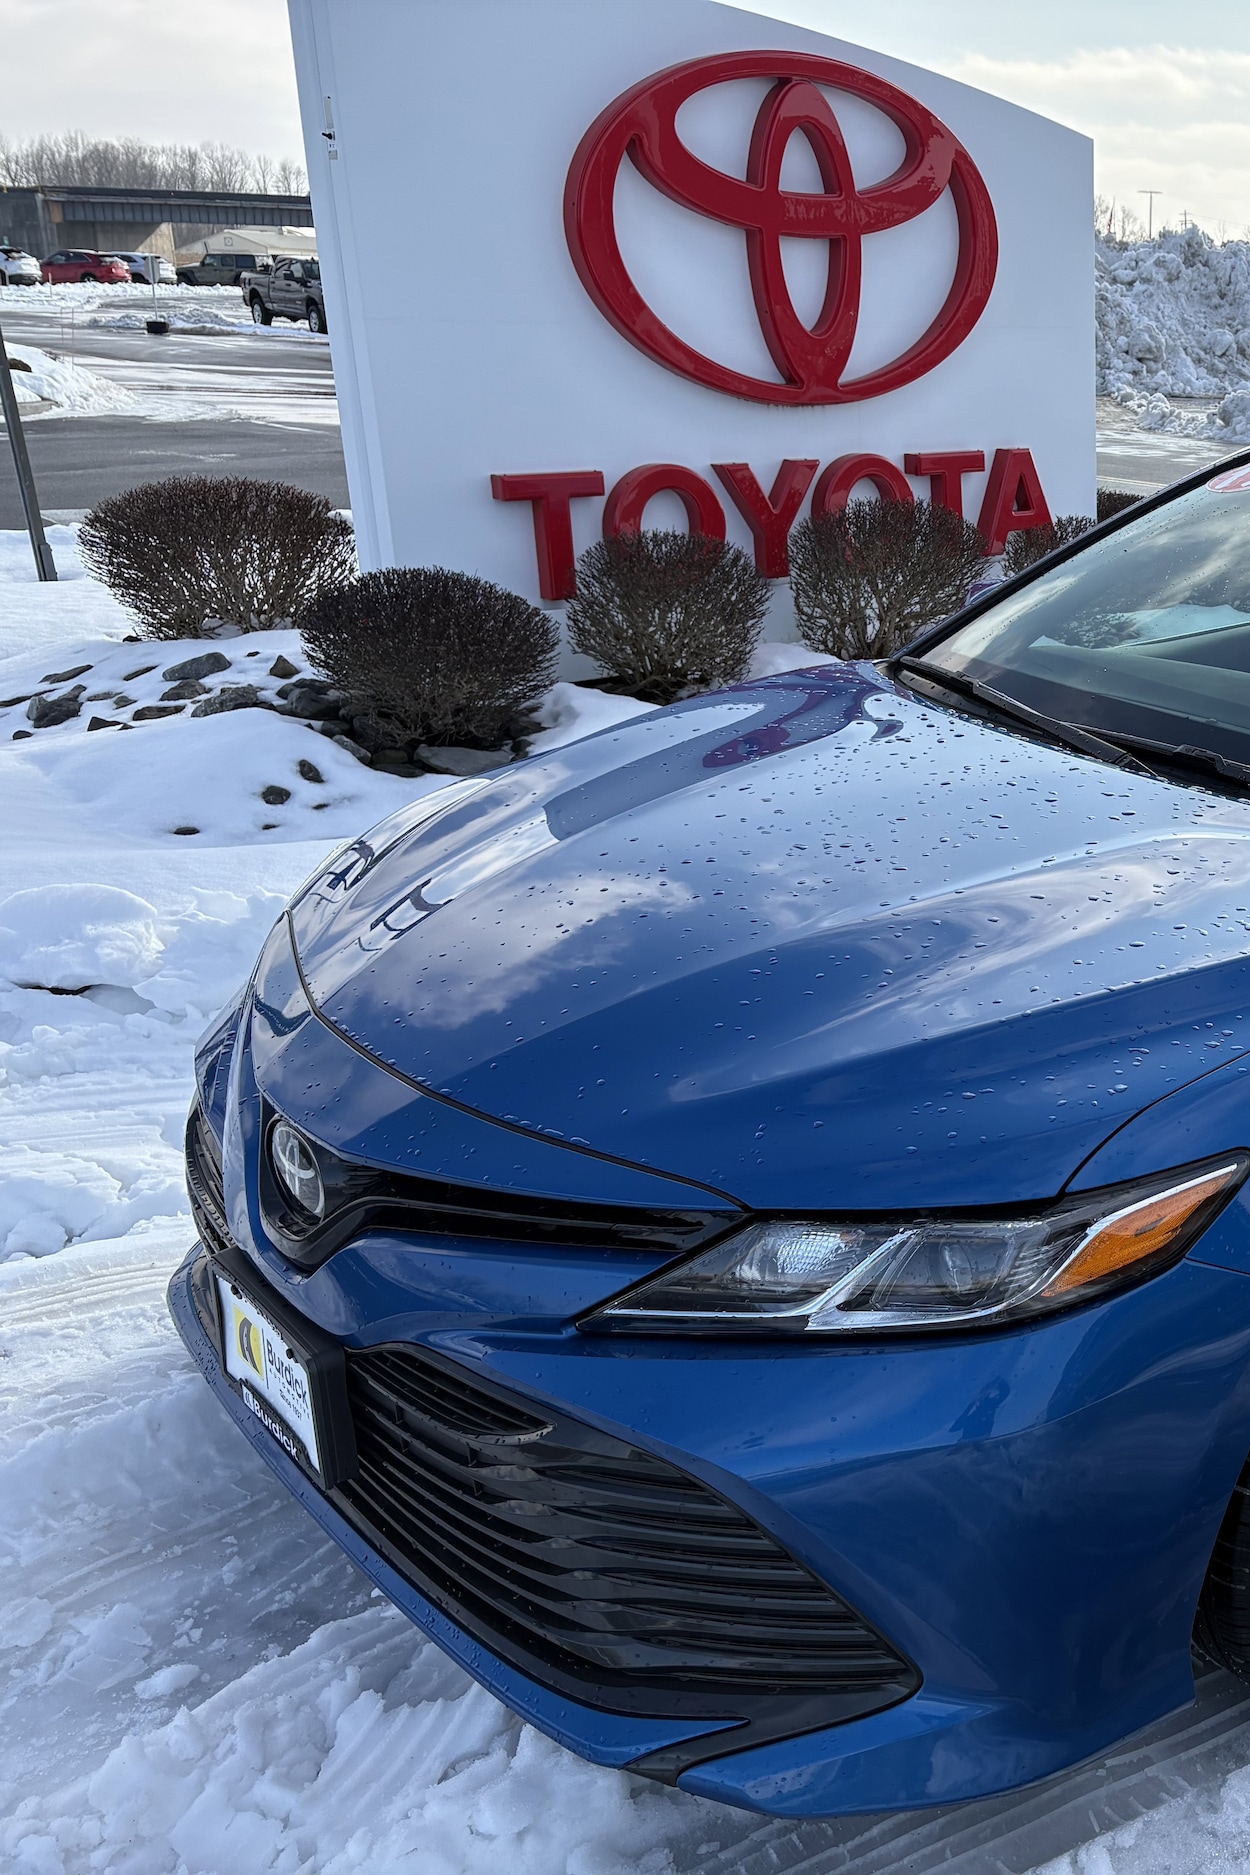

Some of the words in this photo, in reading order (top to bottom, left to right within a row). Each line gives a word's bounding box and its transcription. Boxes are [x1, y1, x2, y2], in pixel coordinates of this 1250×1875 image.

[490, 447, 1054, 601] TOYOTA
[266, 1338, 309, 1410] Burdick
[253, 1397, 299, 1461] Burdick
